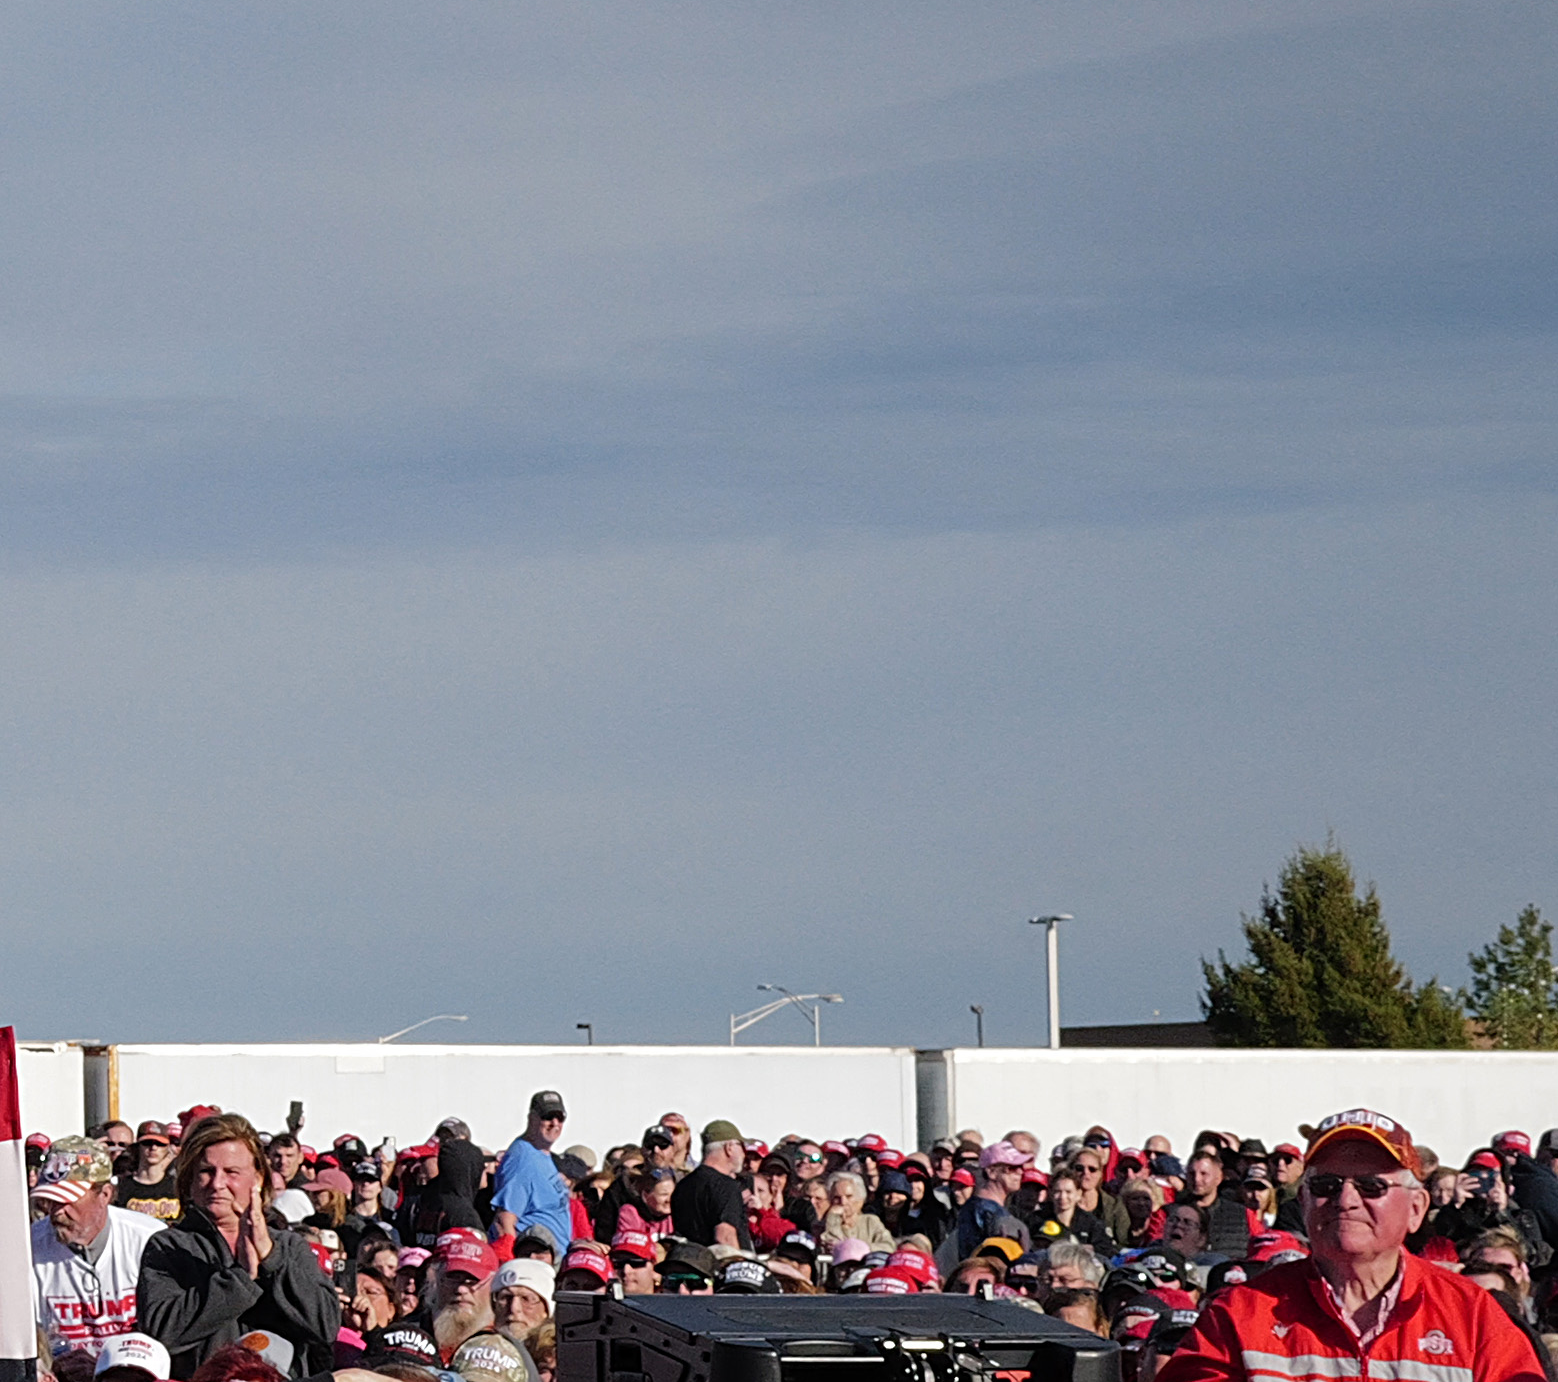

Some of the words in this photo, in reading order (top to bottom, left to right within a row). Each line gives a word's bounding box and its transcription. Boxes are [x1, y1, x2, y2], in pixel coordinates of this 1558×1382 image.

[54, 1295, 136, 1320] TRUMP
[383, 1330, 437, 1356] TRUMP
[464, 1347, 519, 1369] TRUMP
[475, 1360, 501, 1373] 2024
